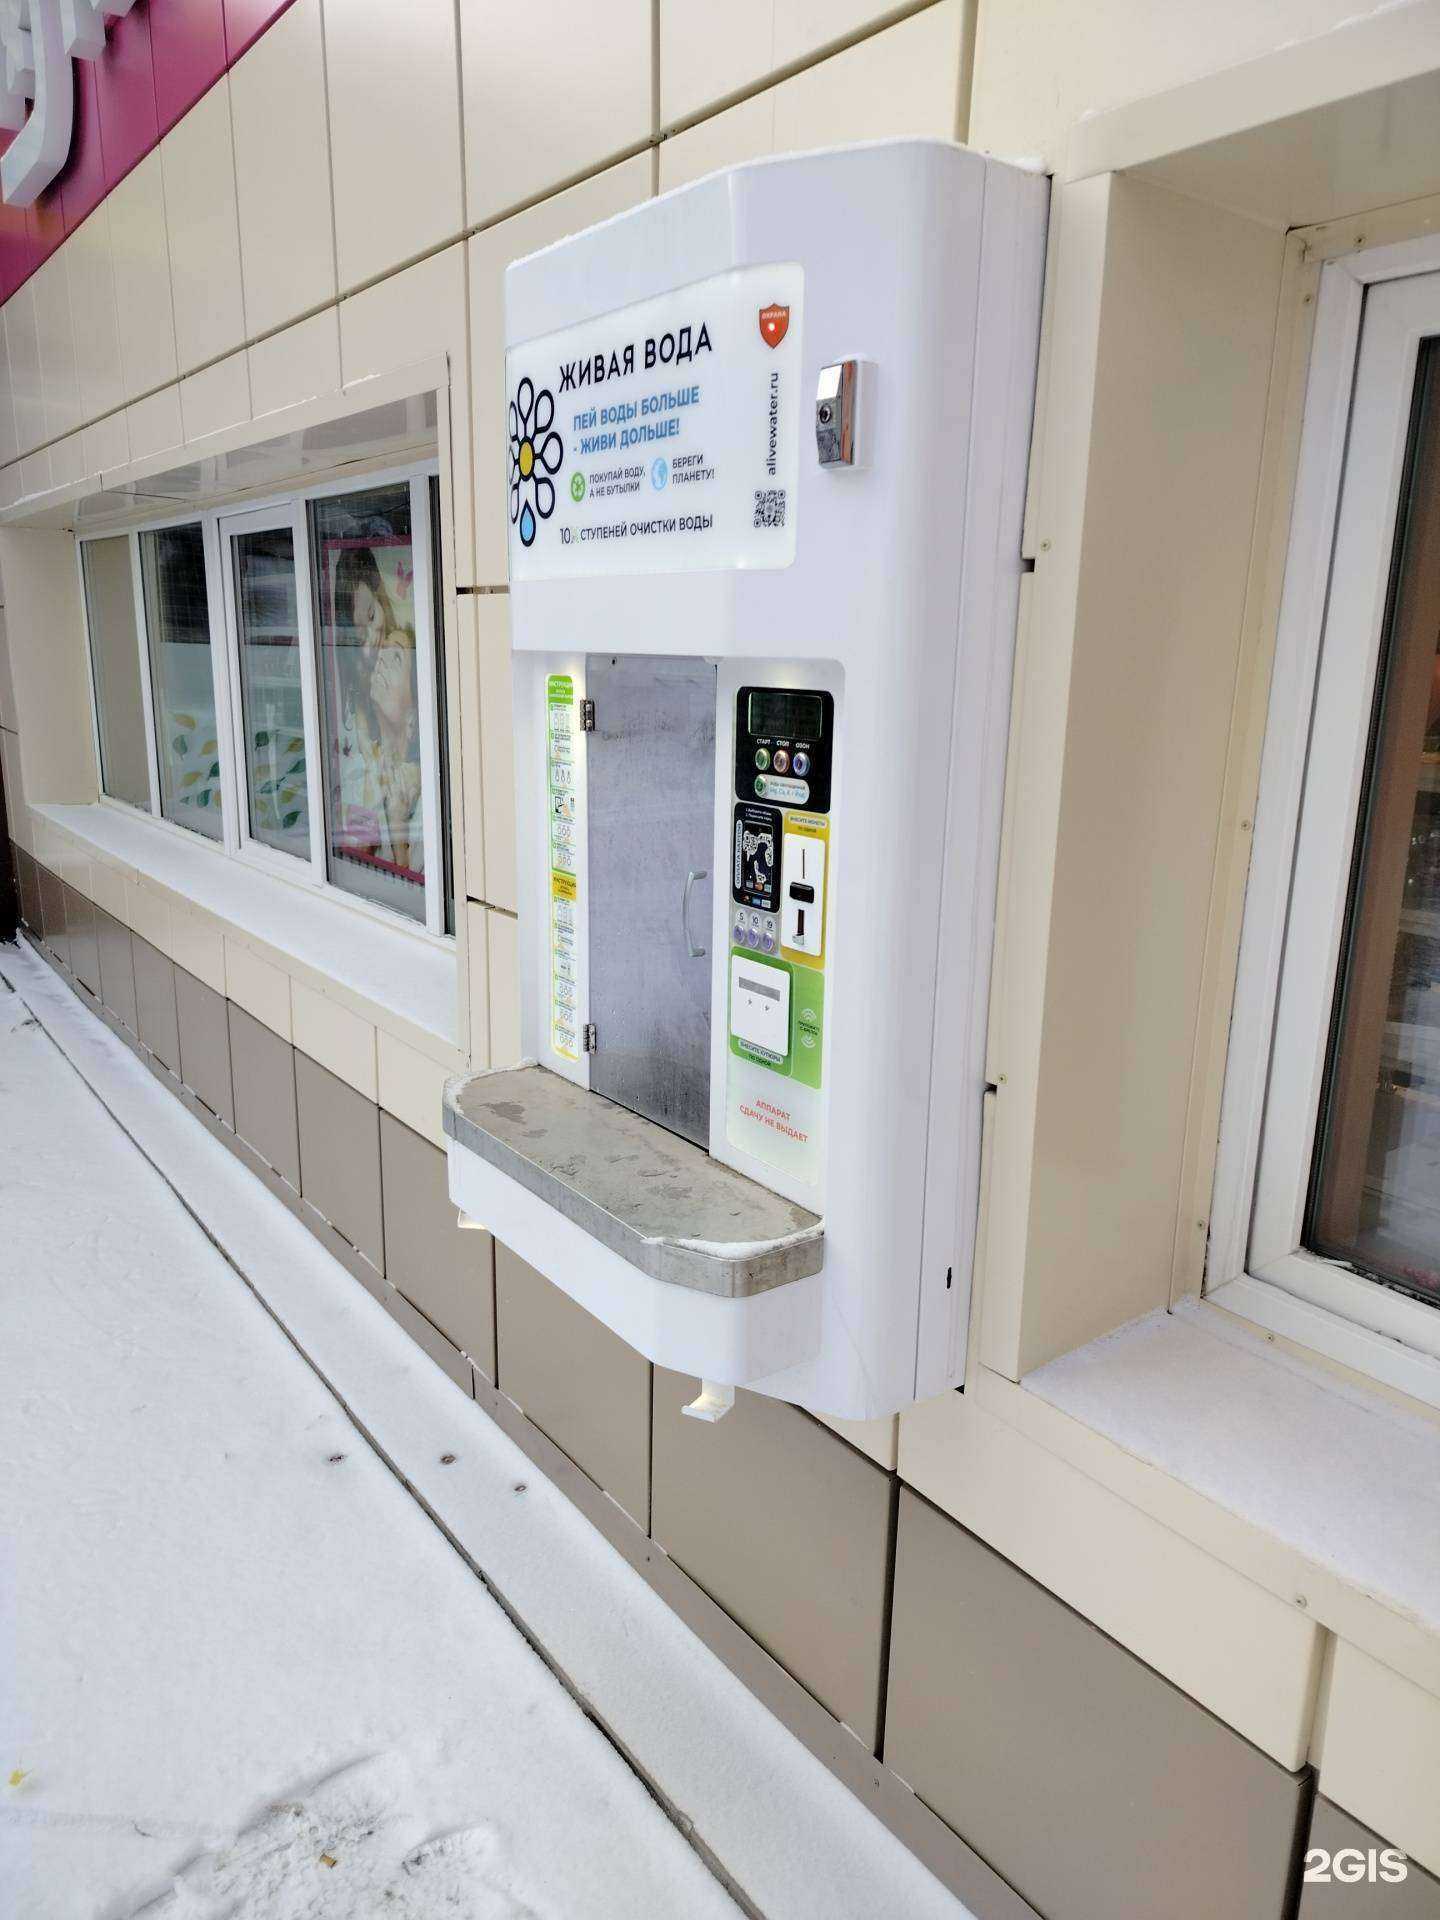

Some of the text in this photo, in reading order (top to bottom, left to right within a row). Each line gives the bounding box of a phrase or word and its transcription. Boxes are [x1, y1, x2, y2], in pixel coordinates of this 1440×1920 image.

[558, 321, 713, 393] ЖИВАЯ ВОДА
[573, 386, 700, 431] ПЕЙ ВОДЫ БОЛЬШЕ
[766, 372, 779, 476] alivewater.ru
[580, 433, 617, 455] ЖИВИ
[619, 418, 680, 450] ДОЛЬШЕ!
[672, 454, 704, 469] БЕРЕГИ
[589, 465, 646, 484] ПОКУПАЙ ВОДУ,
[672, 469, 715, 484] ПЛАНЕТУ!
[589, 481, 640, 498] А НЕ БУТЫЛКИ
[580, 521, 628, 541] СТУПЕНЕЙ
[629, 518, 676, 536] ОЧИСТКИ
[679, 514, 713, 532] ВОДЫ
[739, 912, 744, 921] 5
[752, 916, 759, 924] 10
[755, 1099, 791, 1121] АППАРАТ
[739, 1104, 808, 1143] СДАЧУ НЕ ВЫДАЕТ
